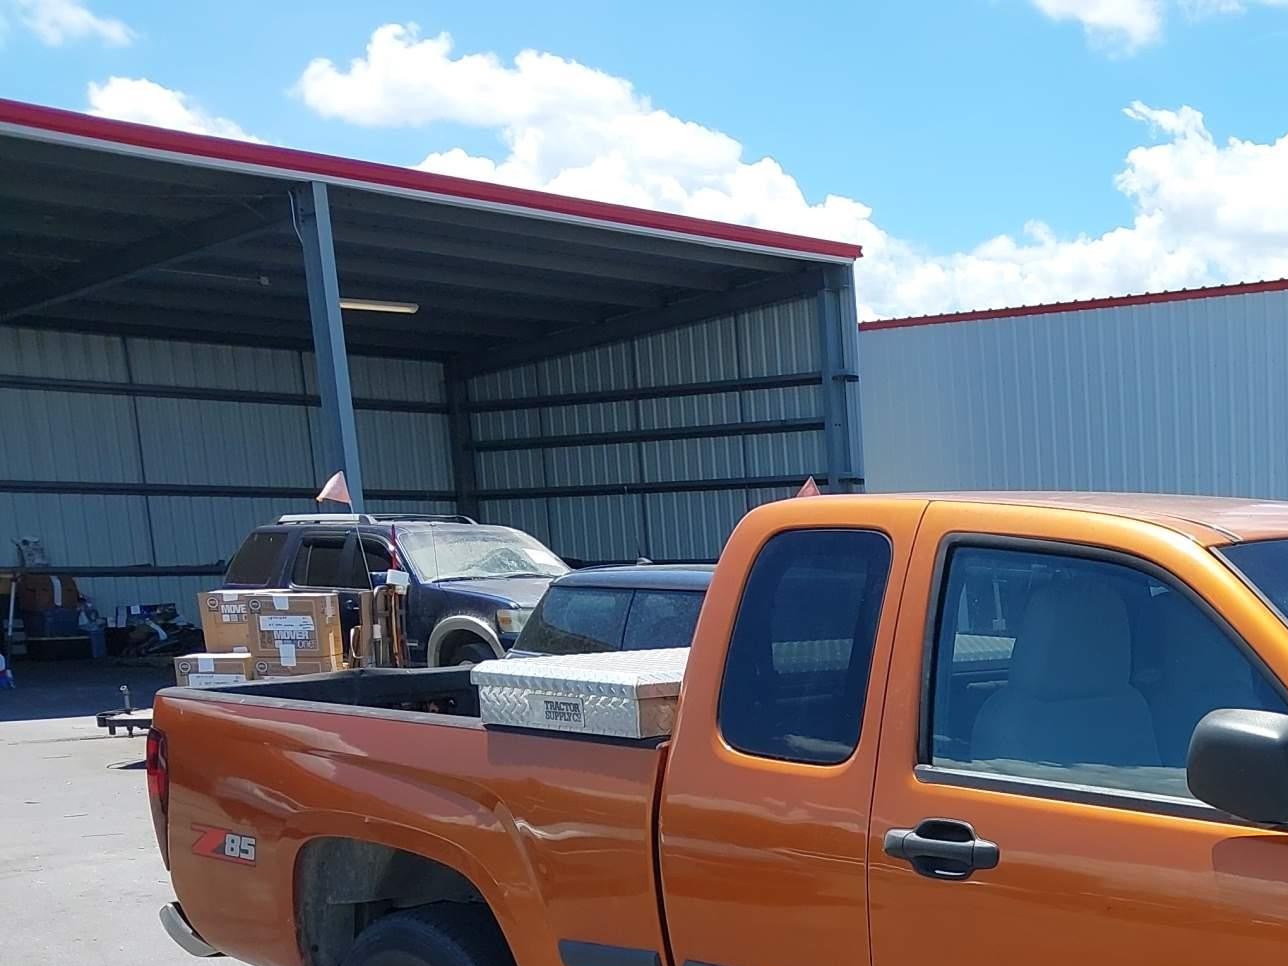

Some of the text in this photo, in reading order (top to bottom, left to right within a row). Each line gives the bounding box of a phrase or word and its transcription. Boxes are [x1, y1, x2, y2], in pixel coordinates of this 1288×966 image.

[221, 604, 247, 613] MOVE
[273, 630, 309, 640] MOVER
[544, 701, 580, 712] TRACTOR
[191, 822, 257, 867] Z85
